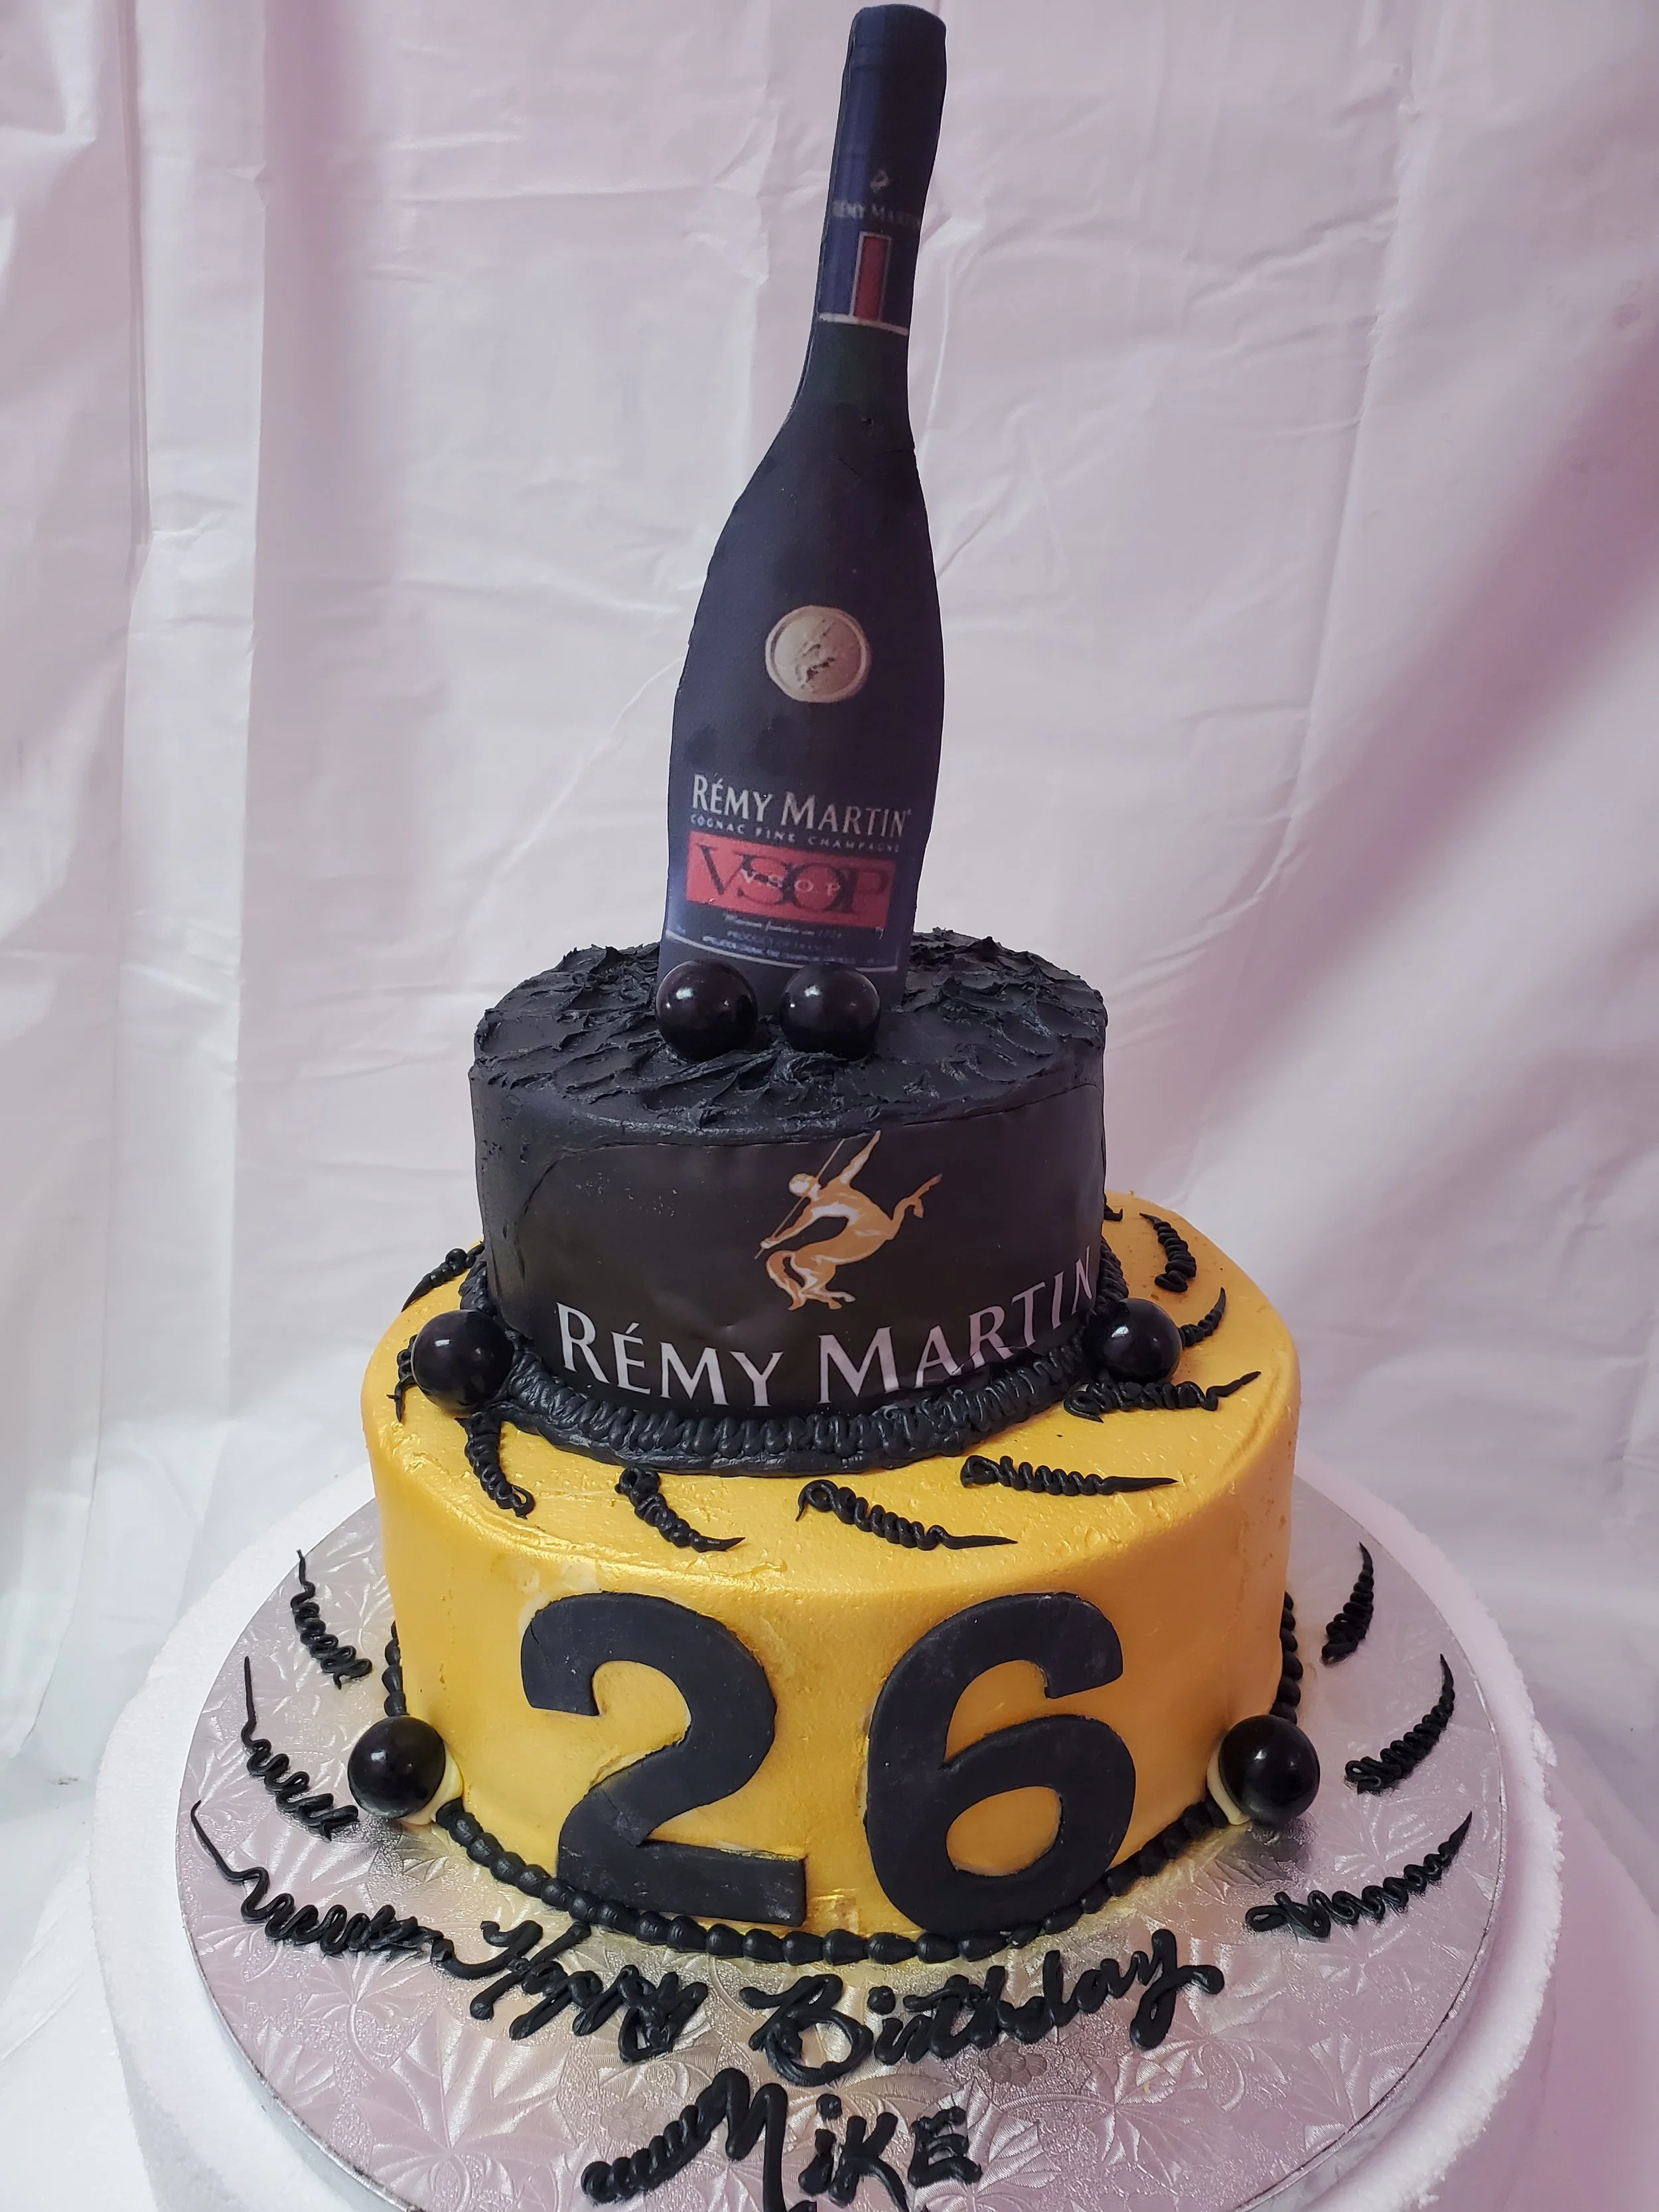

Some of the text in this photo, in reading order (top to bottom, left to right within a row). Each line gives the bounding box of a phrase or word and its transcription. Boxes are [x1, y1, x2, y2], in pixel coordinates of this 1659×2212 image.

[690, 812, 746, 834] COGNAC
[755, 826, 796, 843] FINE
[692, 773, 773, 823] RÉMY
[555, 1245, 1093, 1407] RÉMY MARTIN
[520, 1591, 1136, 1935] 26
[431, 1919, 1226, 2088] Happy Birthday
